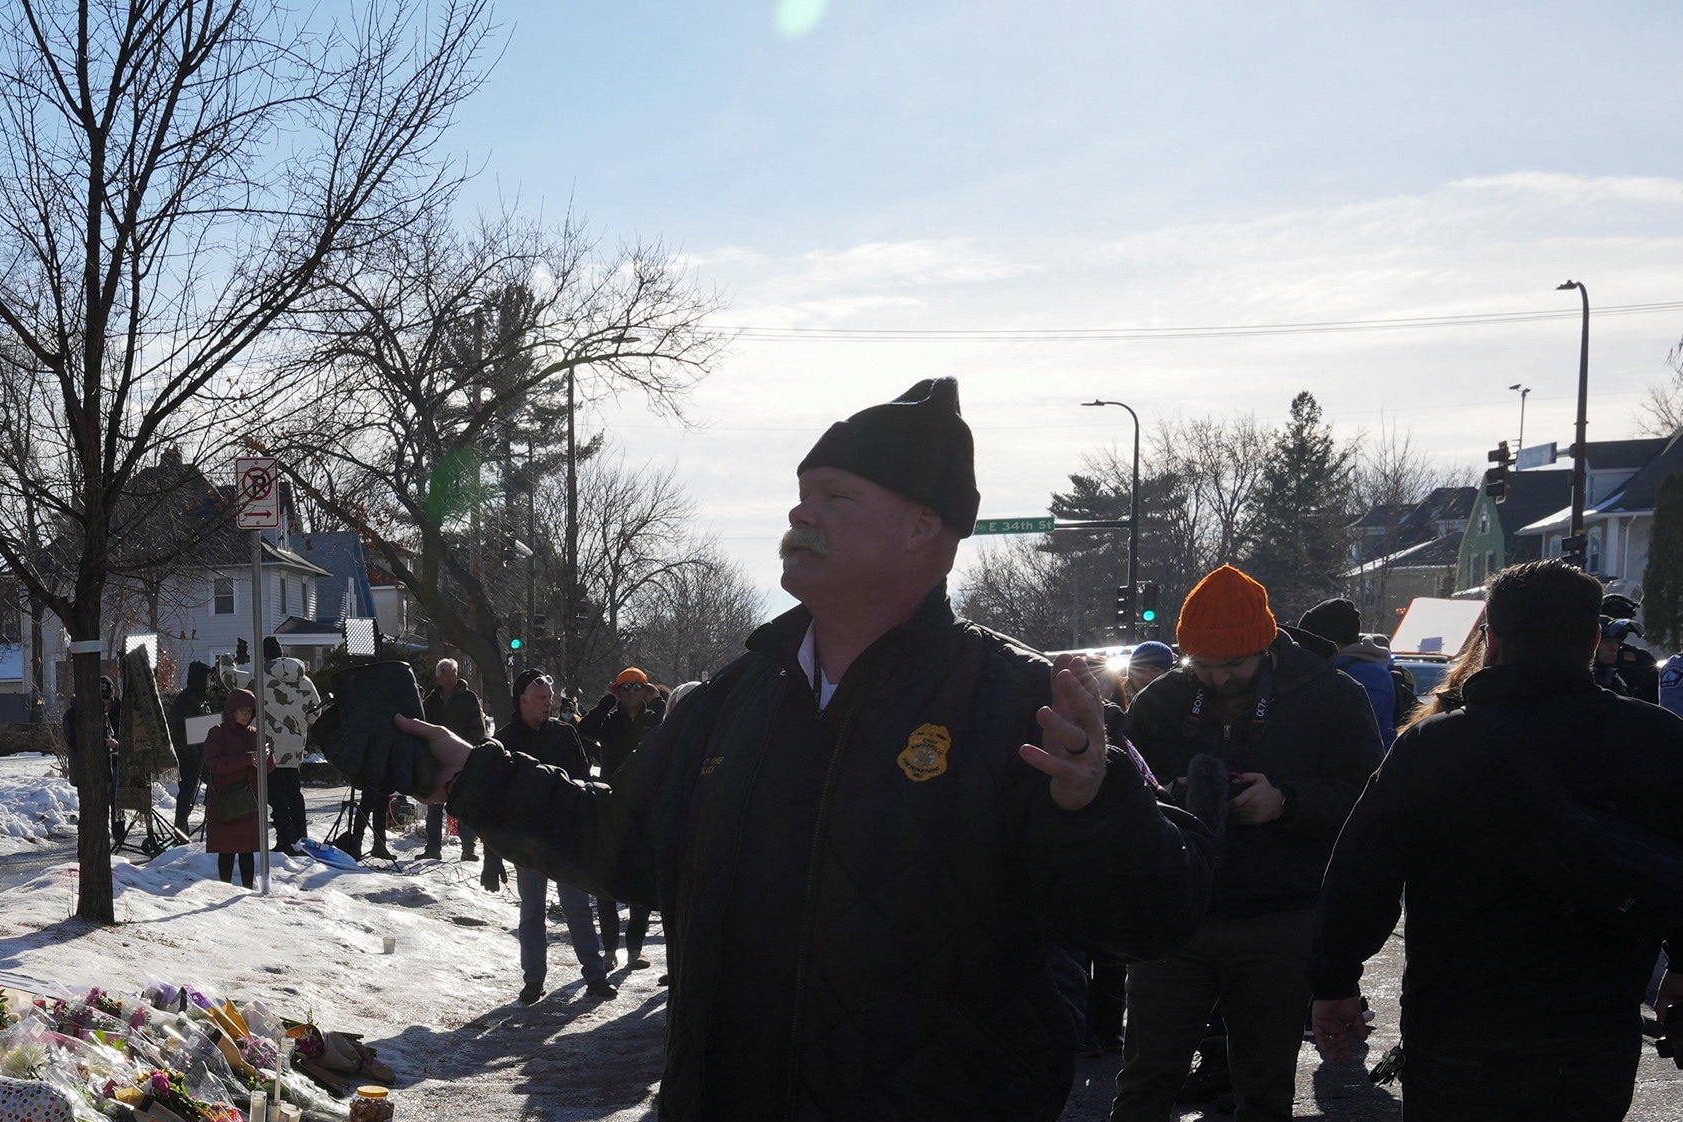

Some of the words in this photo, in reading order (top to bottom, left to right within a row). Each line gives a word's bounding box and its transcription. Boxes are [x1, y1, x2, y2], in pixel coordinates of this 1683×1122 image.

[989, 522, 997, 532] E
[1002, 521, 1033, 531] 34th
[1038, 520, 1052, 530] St
